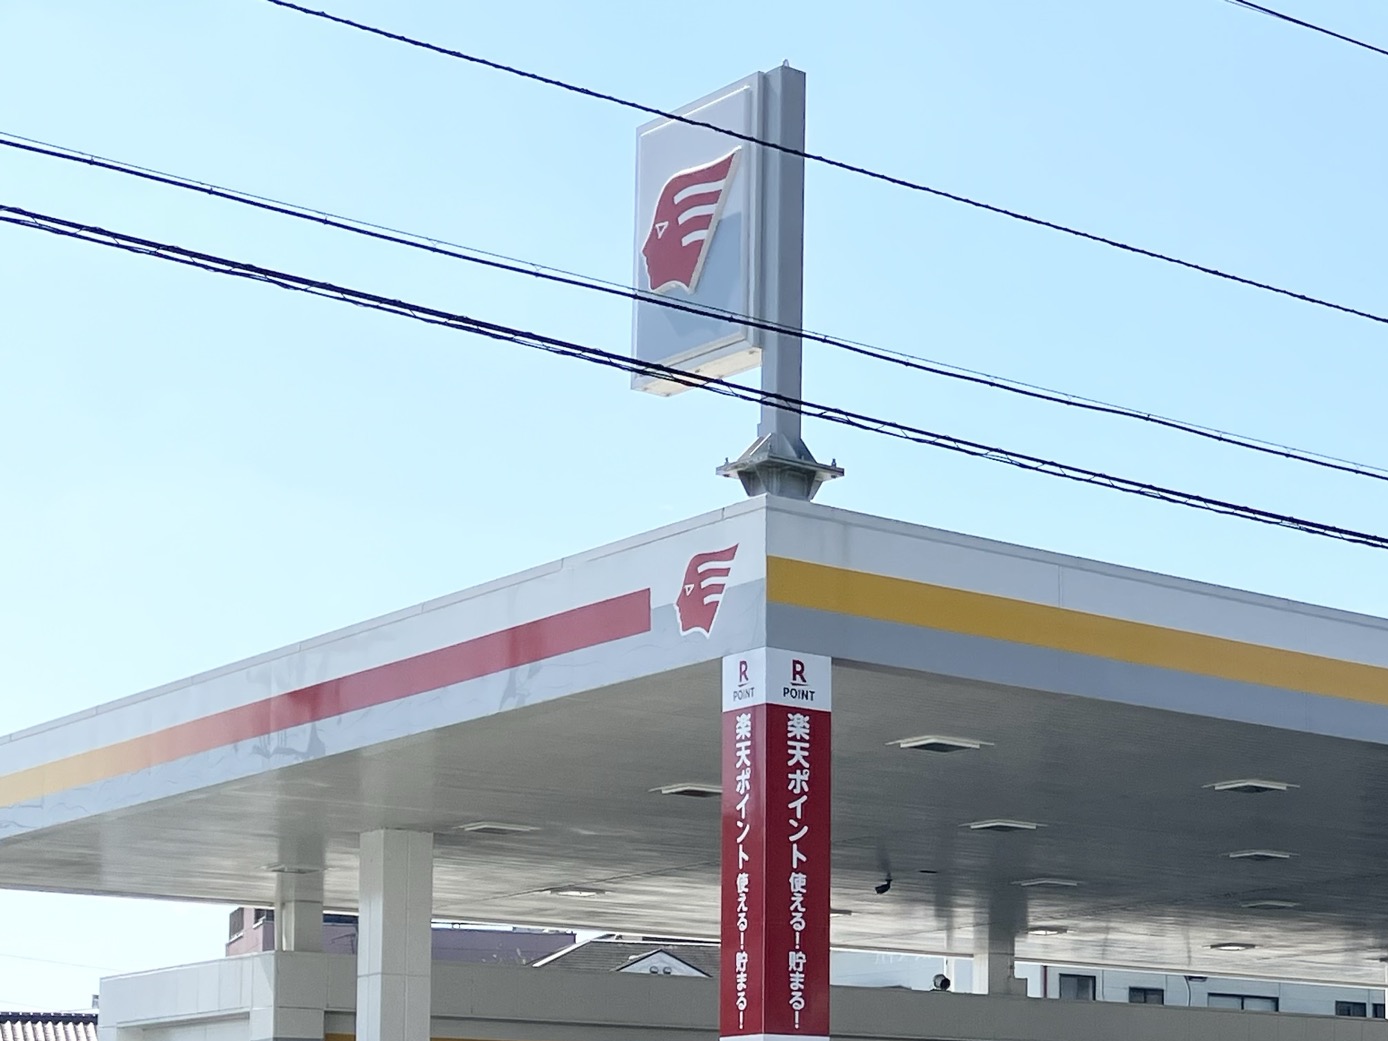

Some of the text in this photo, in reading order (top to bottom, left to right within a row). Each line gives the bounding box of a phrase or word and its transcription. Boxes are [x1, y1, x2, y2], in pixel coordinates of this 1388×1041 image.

[739, 660, 748, 682] R
[791, 659, 806, 684] R
[733, 687, 755, 702] POINT
[783, 687, 816, 702] POINT
